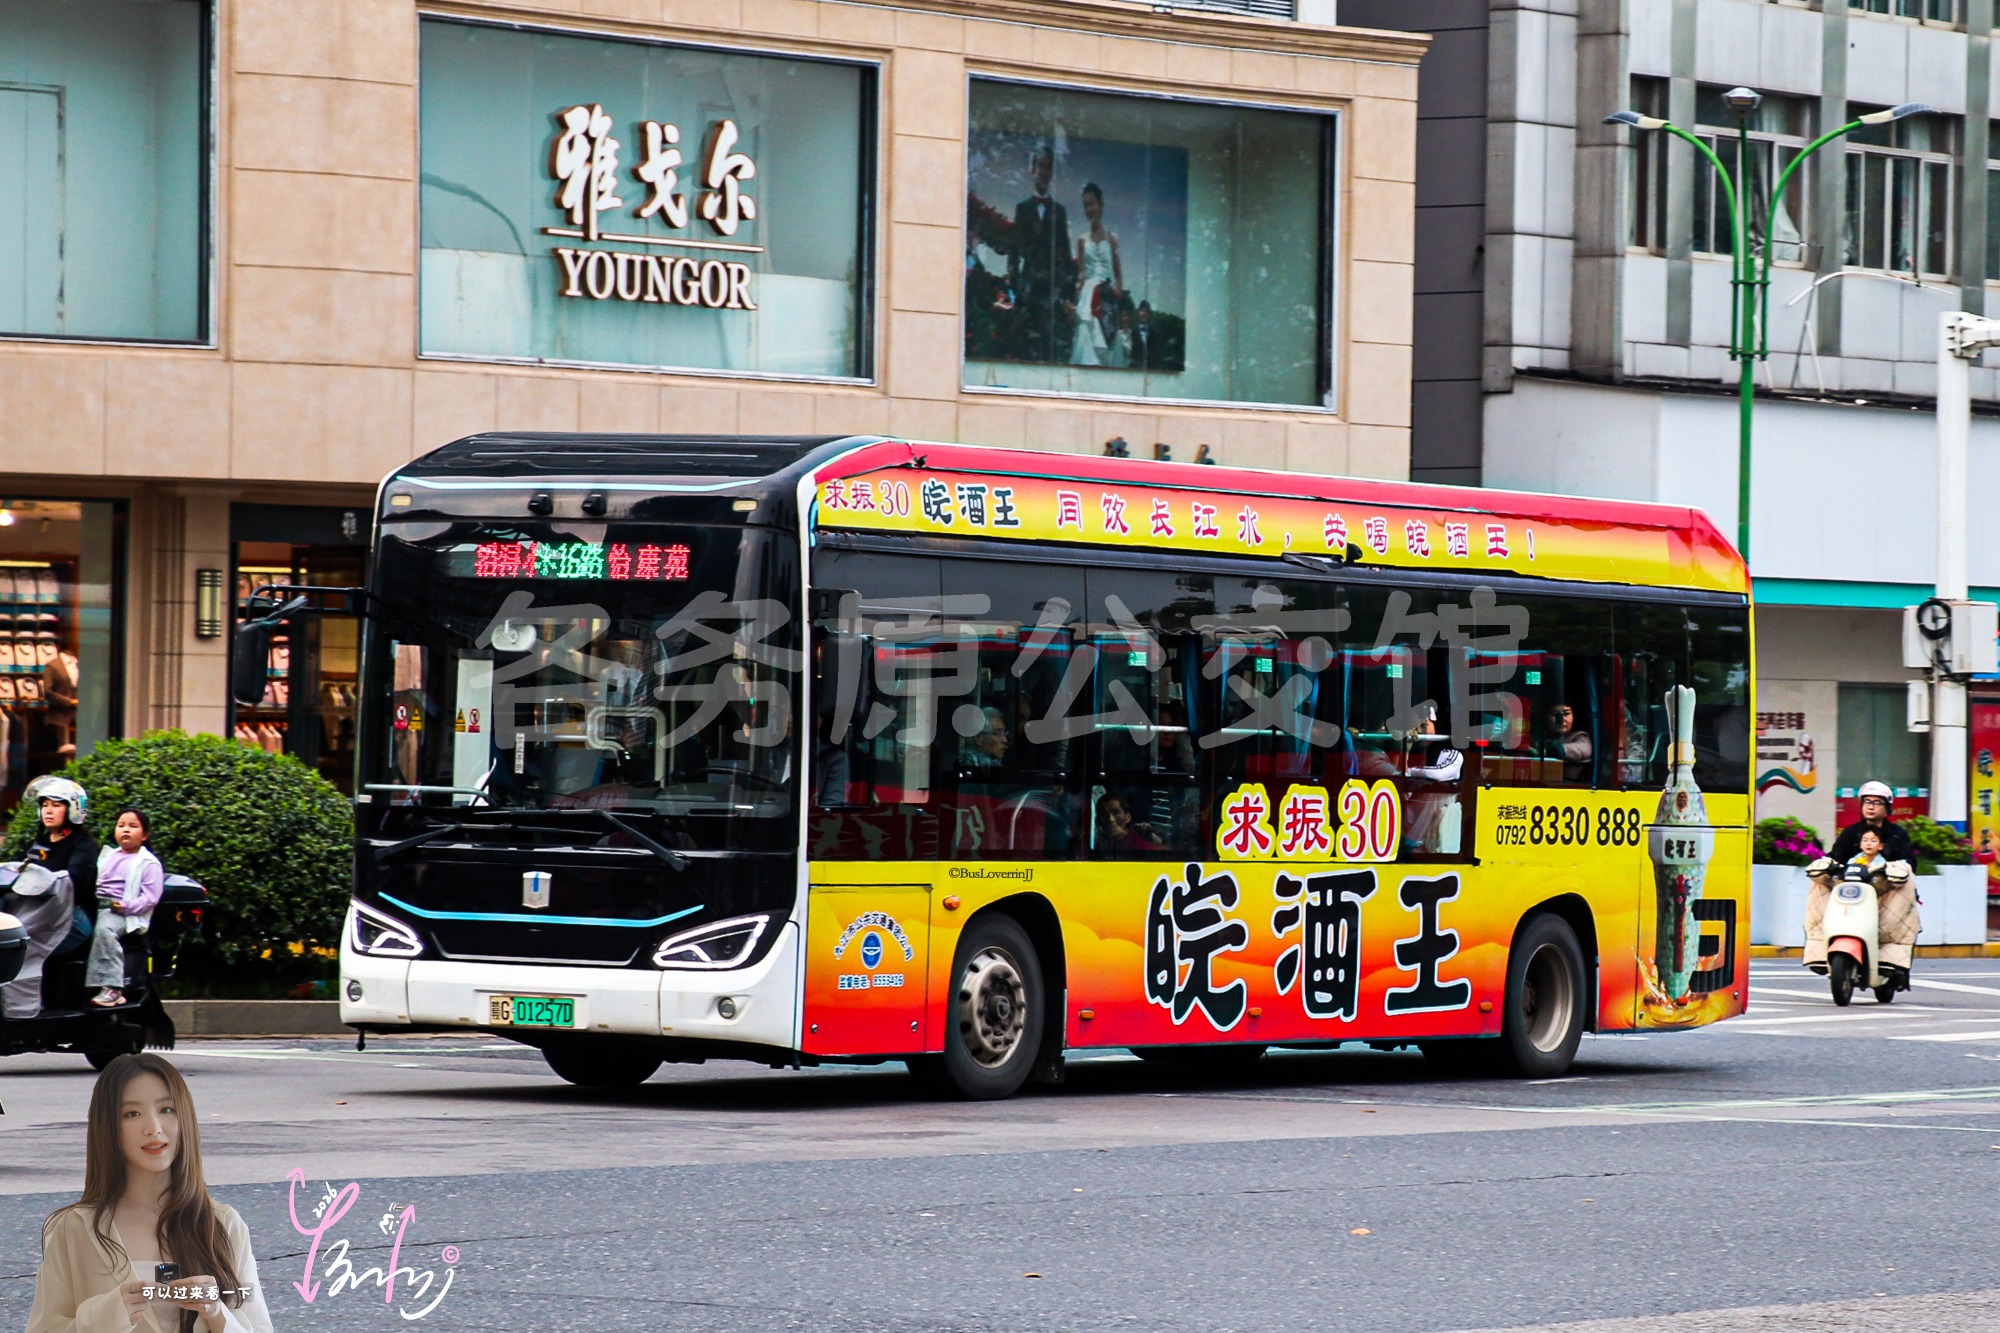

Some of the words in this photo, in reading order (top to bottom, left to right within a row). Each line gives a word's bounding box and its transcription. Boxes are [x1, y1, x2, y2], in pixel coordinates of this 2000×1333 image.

[551, 103, 757, 240] 雅戈尔
[555, 248, 757, 310] YOUNGOR
[823, 479, 910, 517] 求振30
[921, 478, 1020, 528] 皖酒王
[1222, 790, 1397, 858] 求振30
[1496, 825, 1527, 845] 0792
[1529, 805, 1590, 846] 8330
[1596, 806, 1641, 847] 888
[1144, 861, 1472, 1031] 皖酒王
